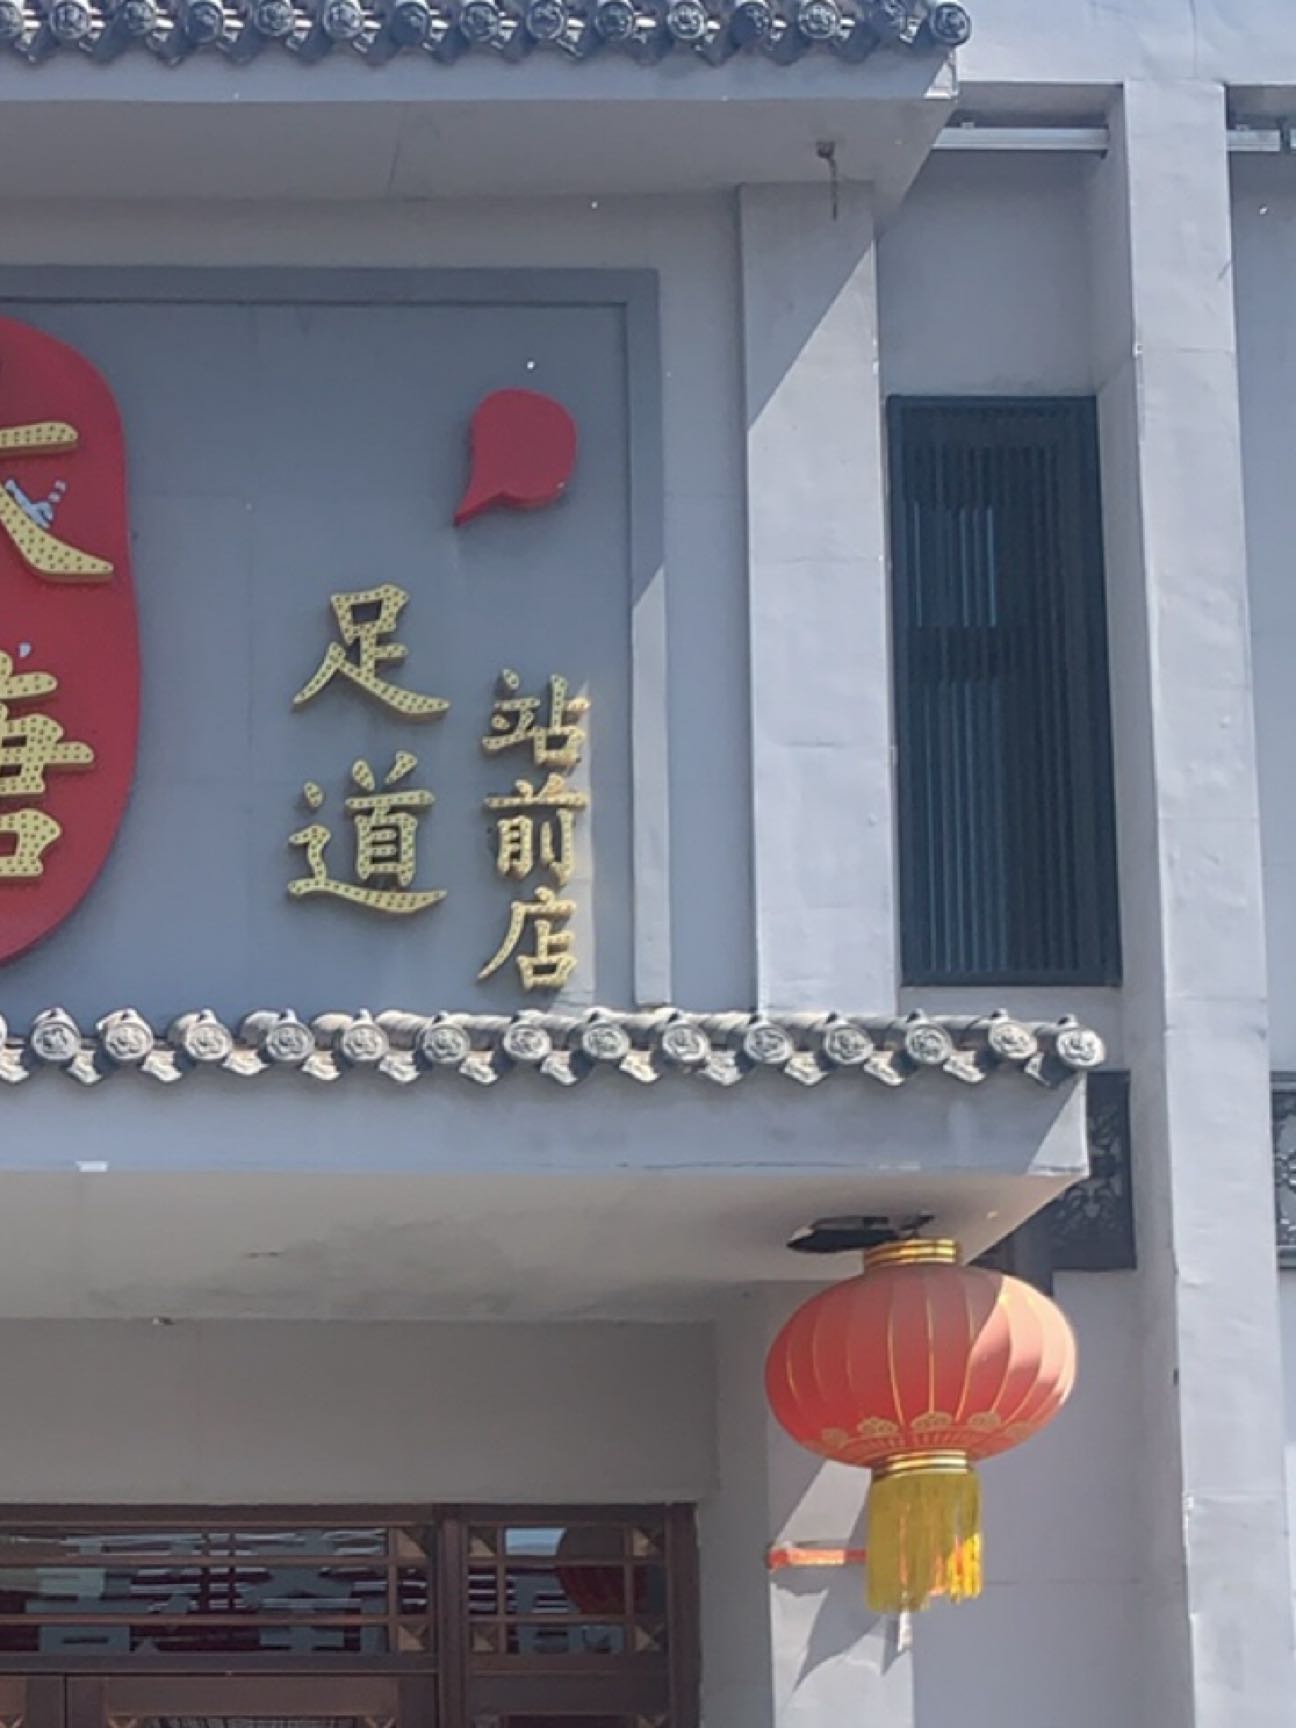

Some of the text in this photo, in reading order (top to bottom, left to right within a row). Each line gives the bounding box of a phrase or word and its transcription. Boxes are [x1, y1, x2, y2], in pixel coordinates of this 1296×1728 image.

[287, 582, 452, 916] 足道
[478, 668, 592, 991] 站前店
